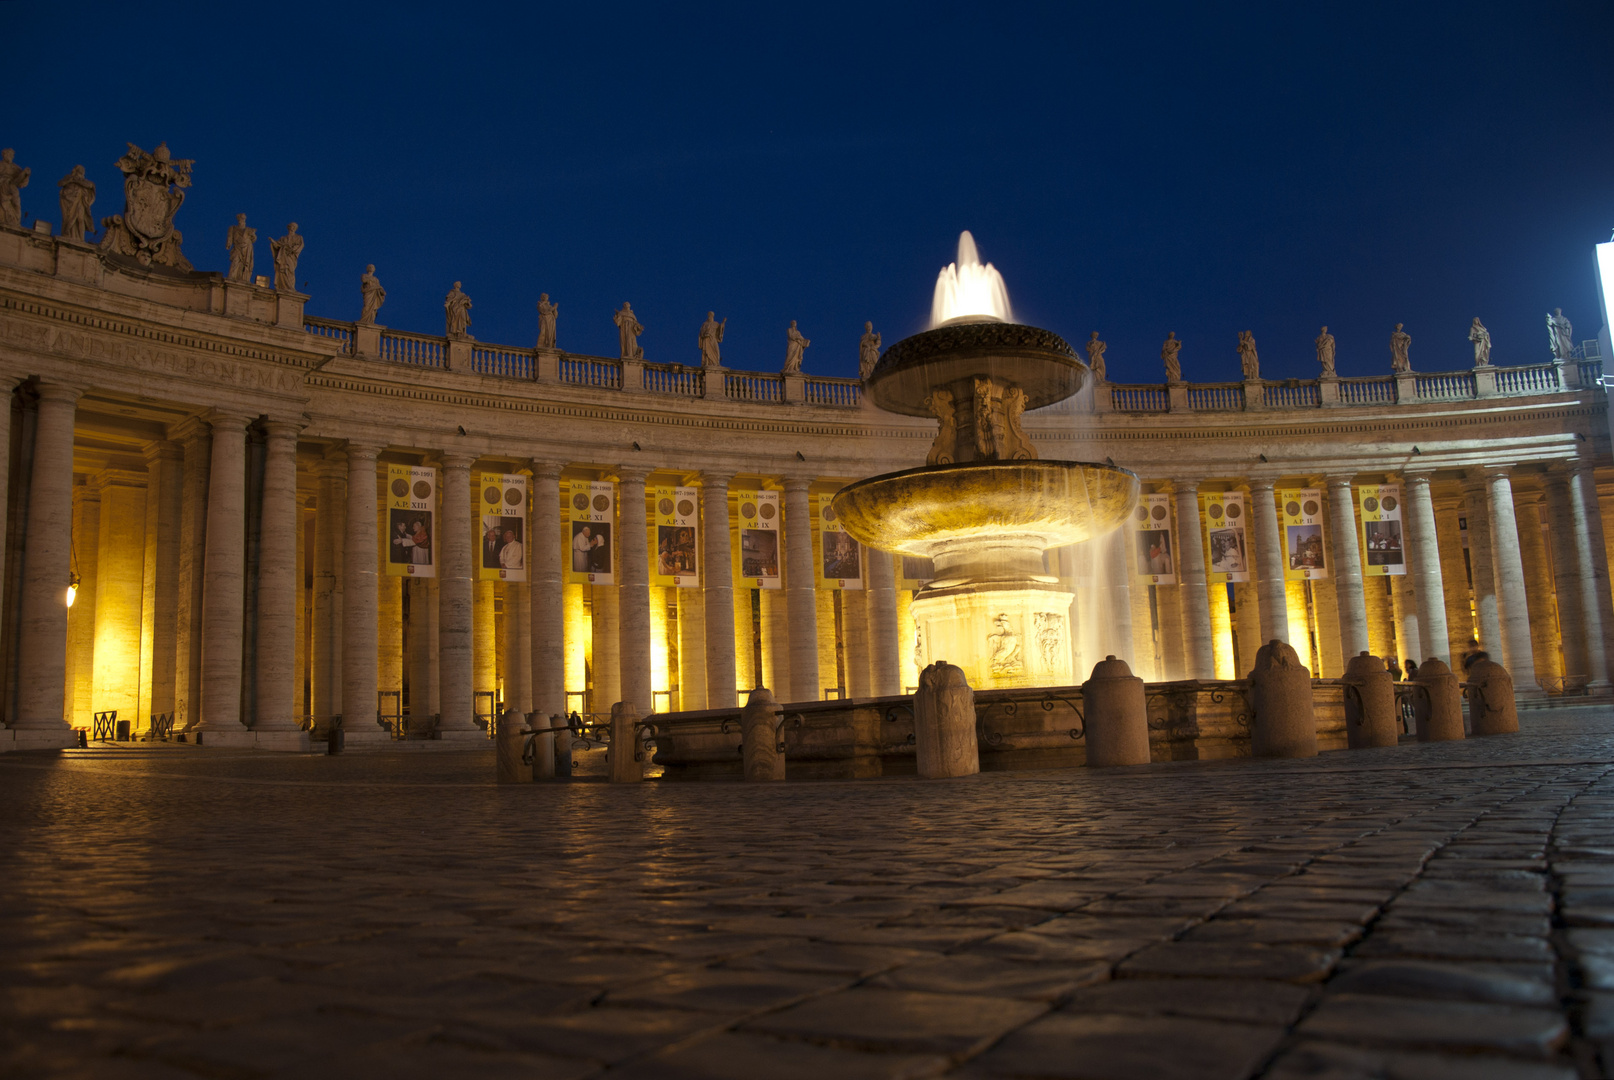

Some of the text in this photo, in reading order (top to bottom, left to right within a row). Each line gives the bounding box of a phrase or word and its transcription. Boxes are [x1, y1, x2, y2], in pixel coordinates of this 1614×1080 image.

[394, 500, 409, 508] A.P.
[488, 507, 517, 516] A.P. XII
